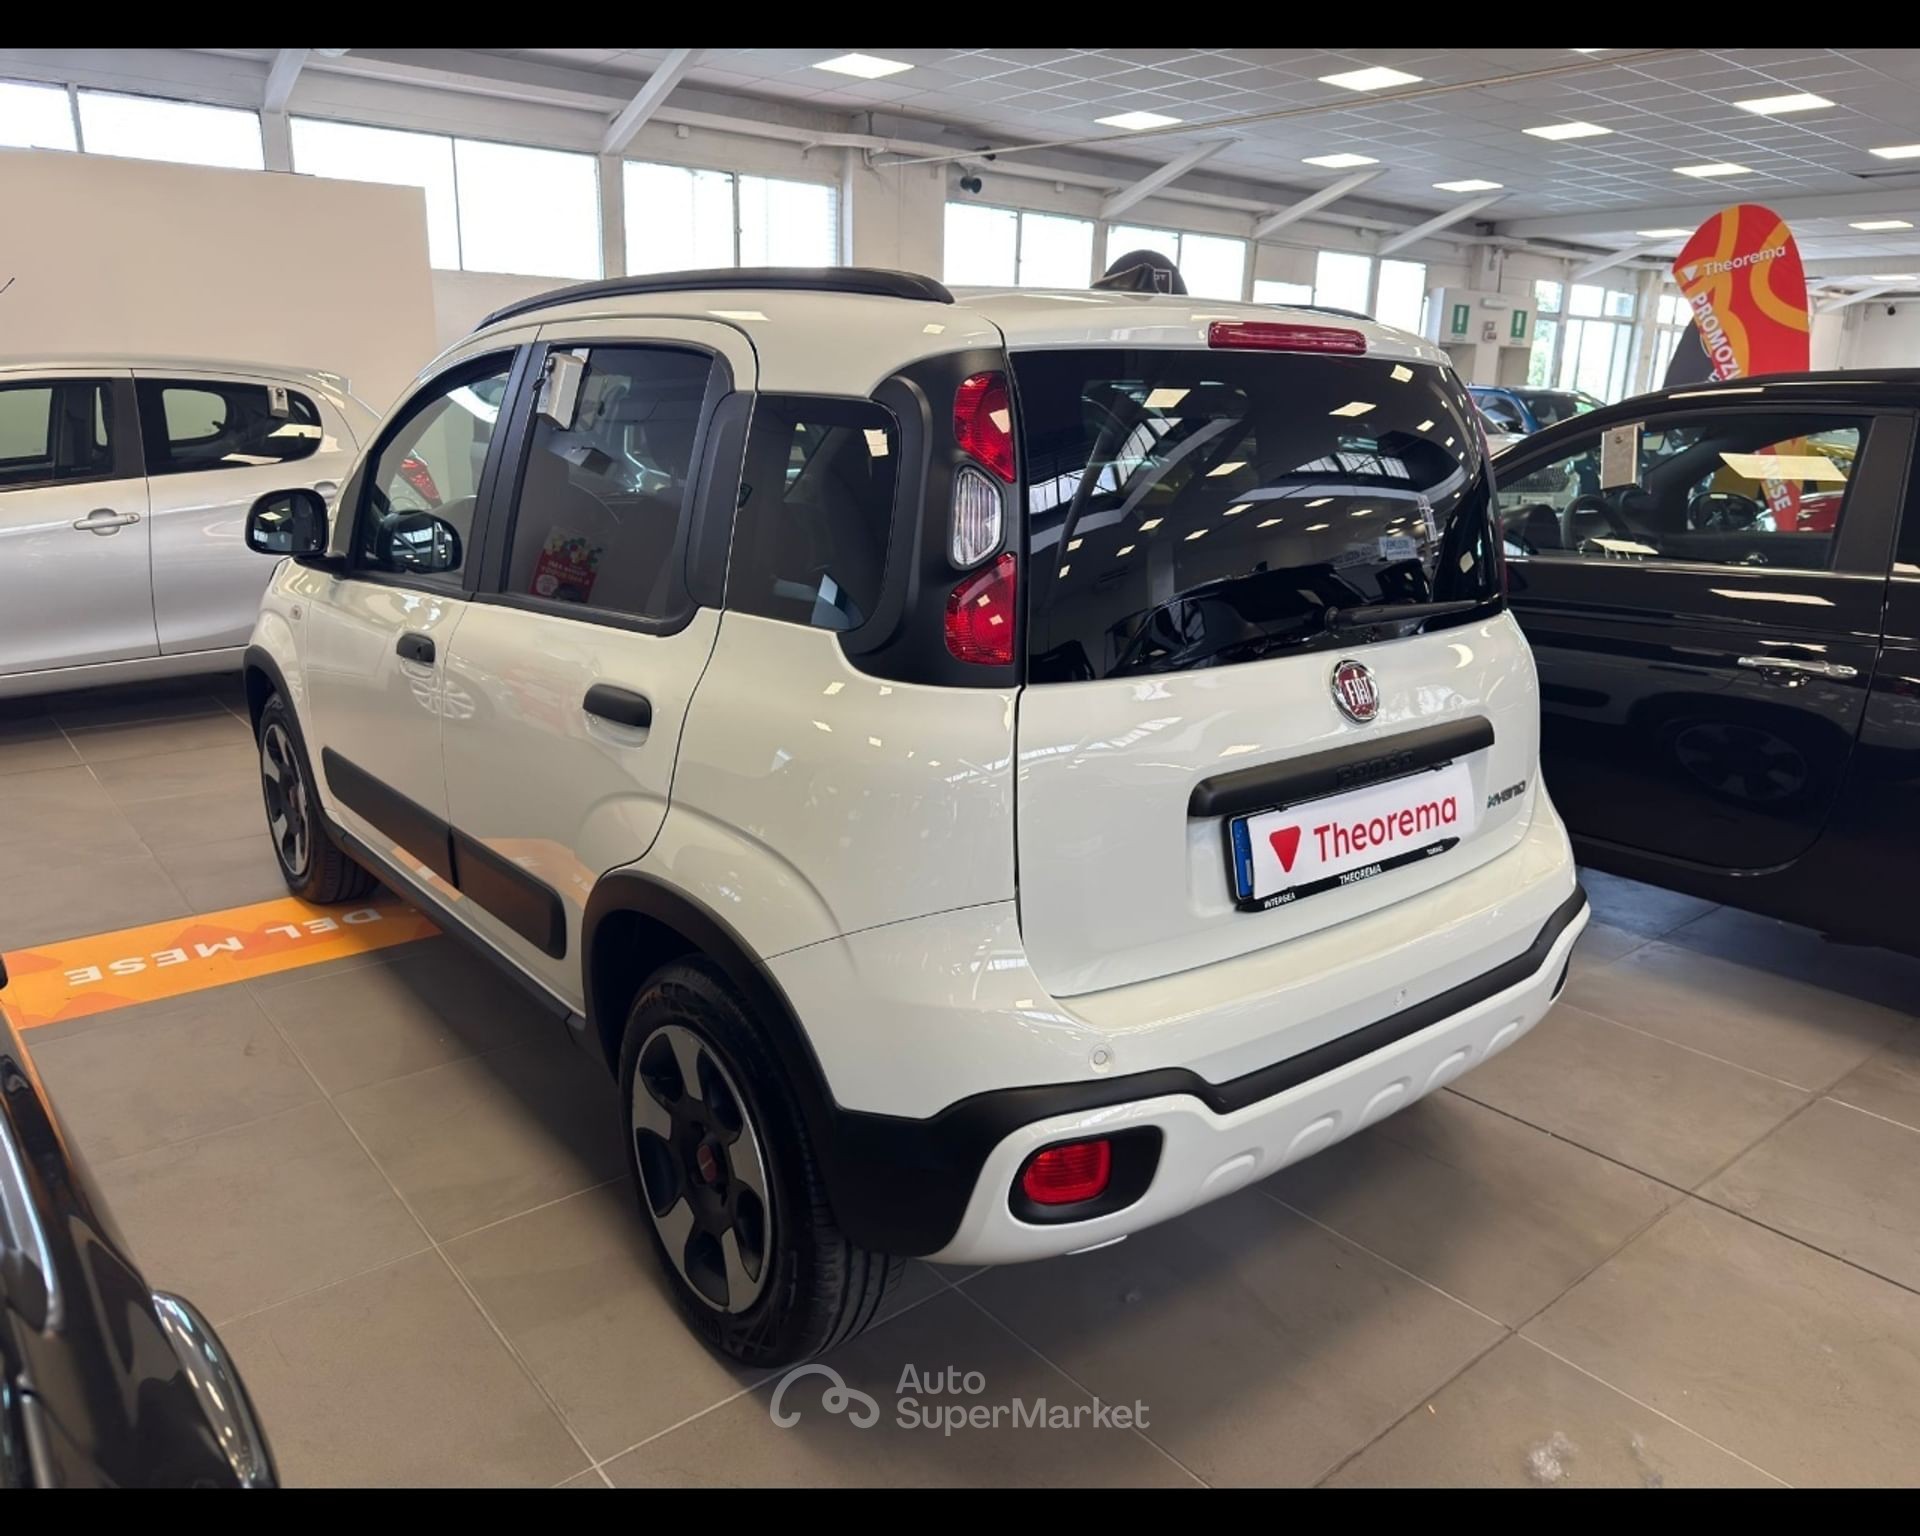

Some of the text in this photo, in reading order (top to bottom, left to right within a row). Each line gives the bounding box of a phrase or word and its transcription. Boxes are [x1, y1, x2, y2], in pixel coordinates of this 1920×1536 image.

[1704, 246, 1786, 277] Theorema
[1344, 676, 1372, 706] FIAT
[1314, 797, 1457, 861] Theorema
[1339, 864, 1382, 885] THEOREMA
[64, 909, 381, 986] DEL MESE
